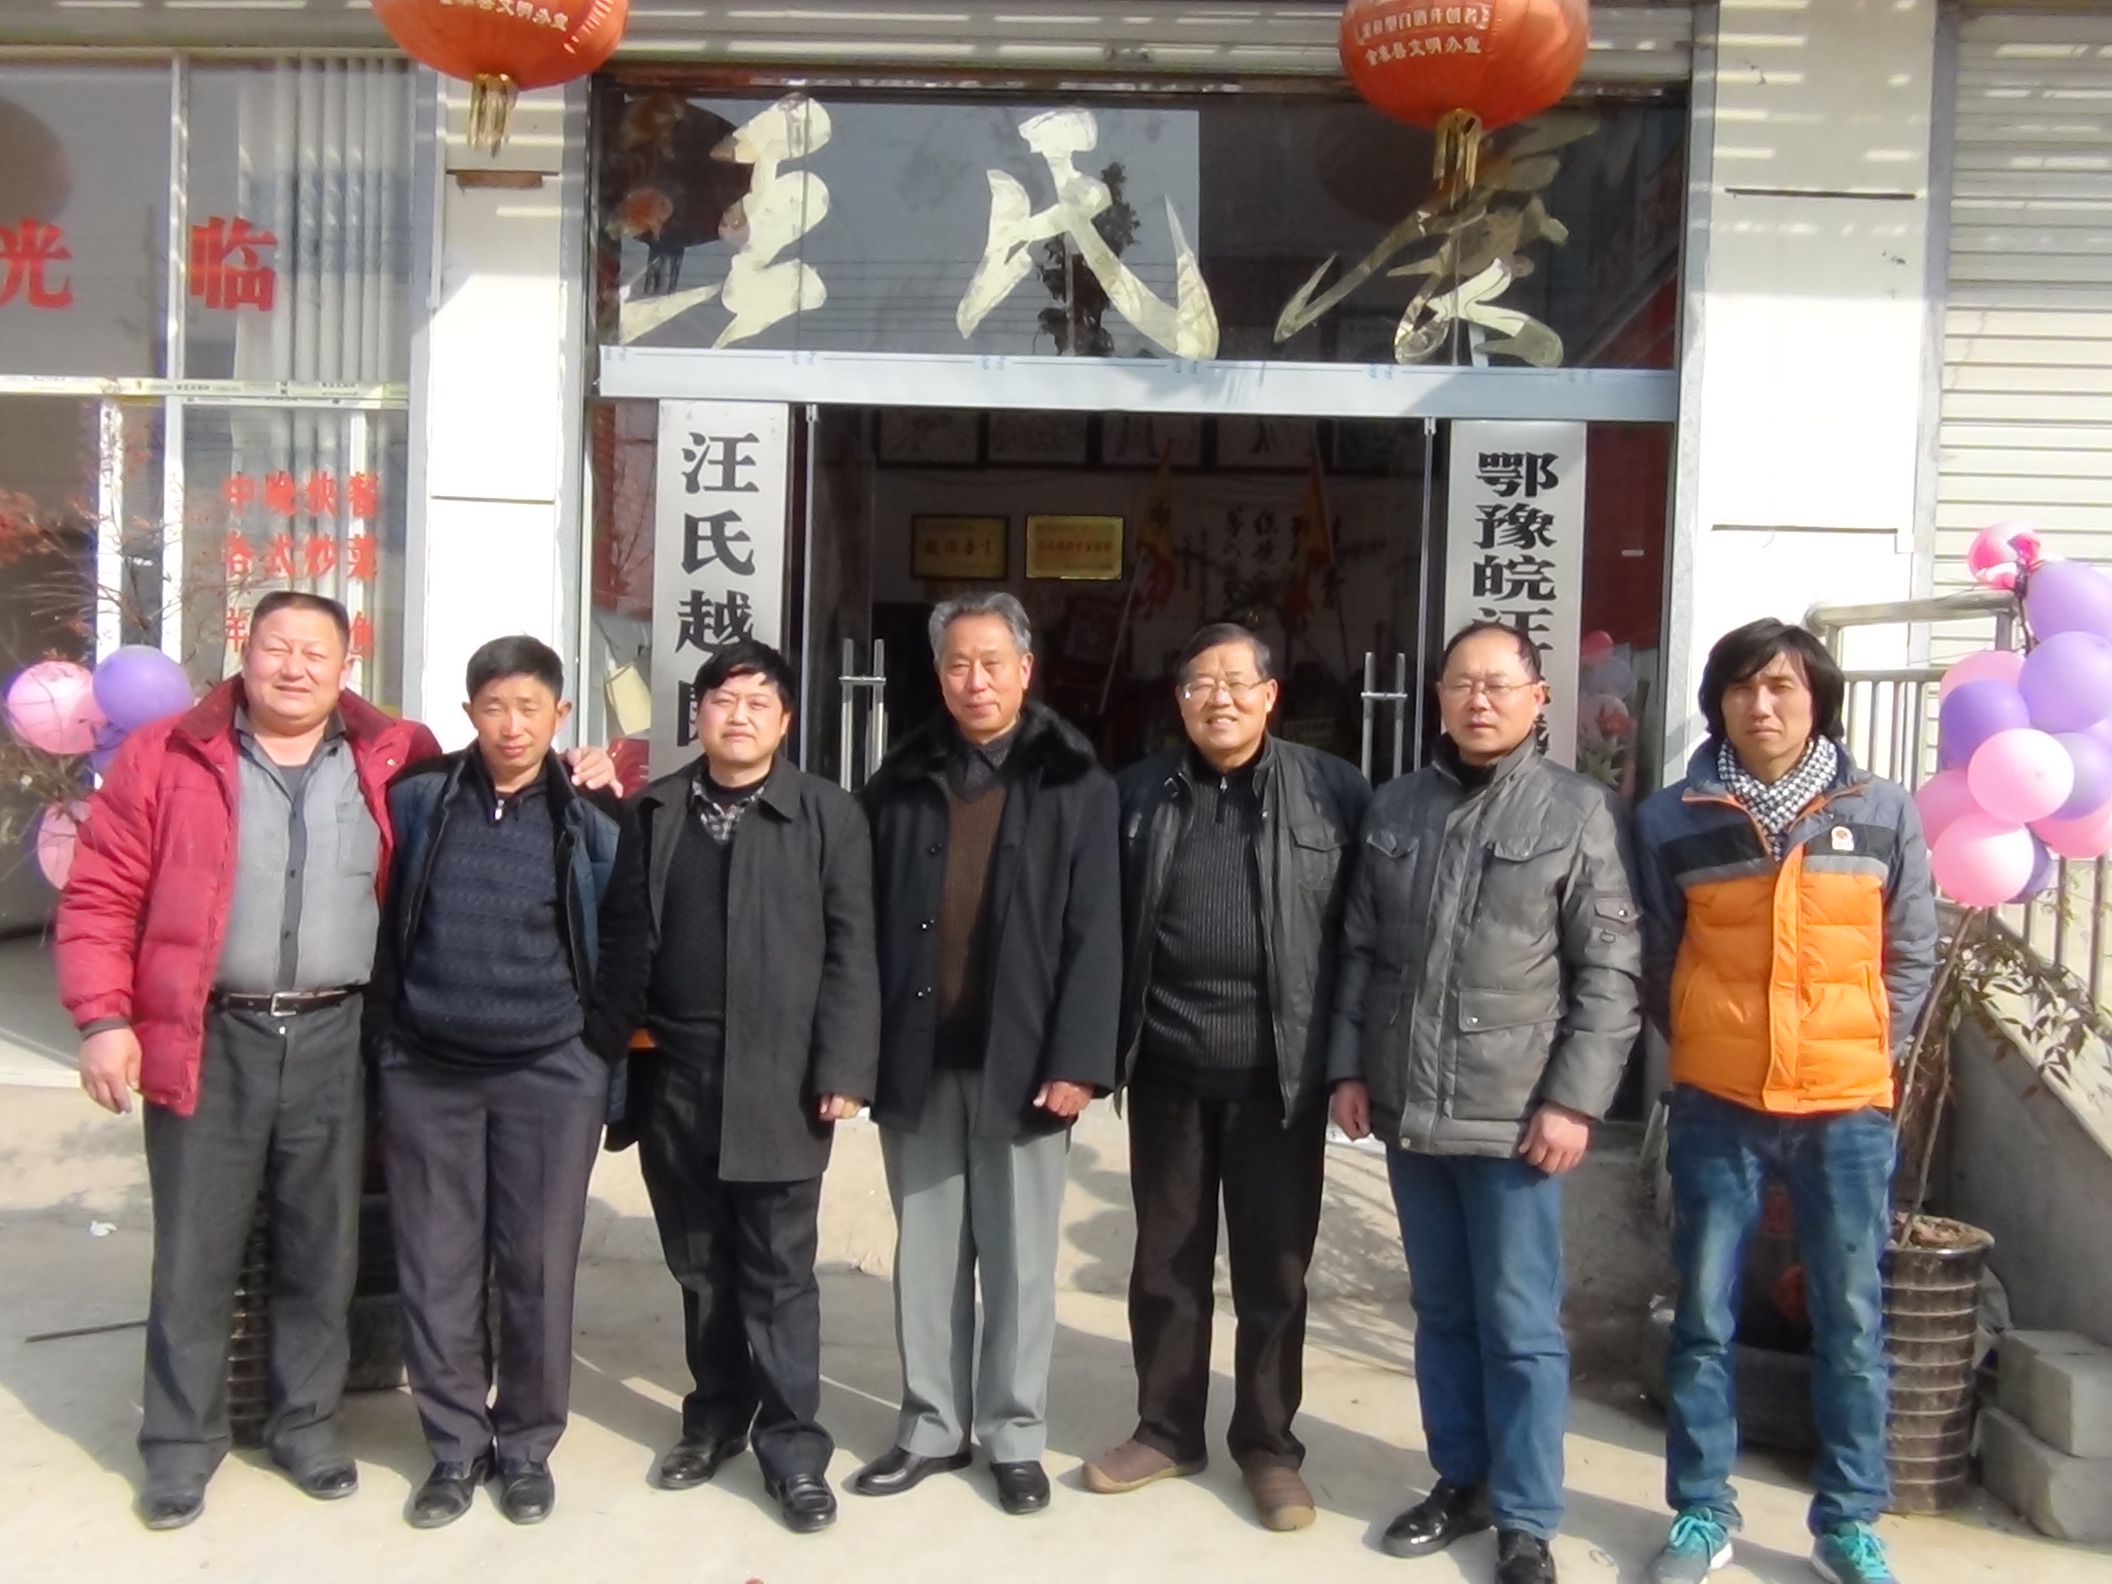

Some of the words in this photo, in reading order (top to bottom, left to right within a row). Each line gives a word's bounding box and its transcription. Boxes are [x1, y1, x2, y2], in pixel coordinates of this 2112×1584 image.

[222, 531, 379, 579] 各式炒菜
[675, 432, 760, 748] 汪氏越
